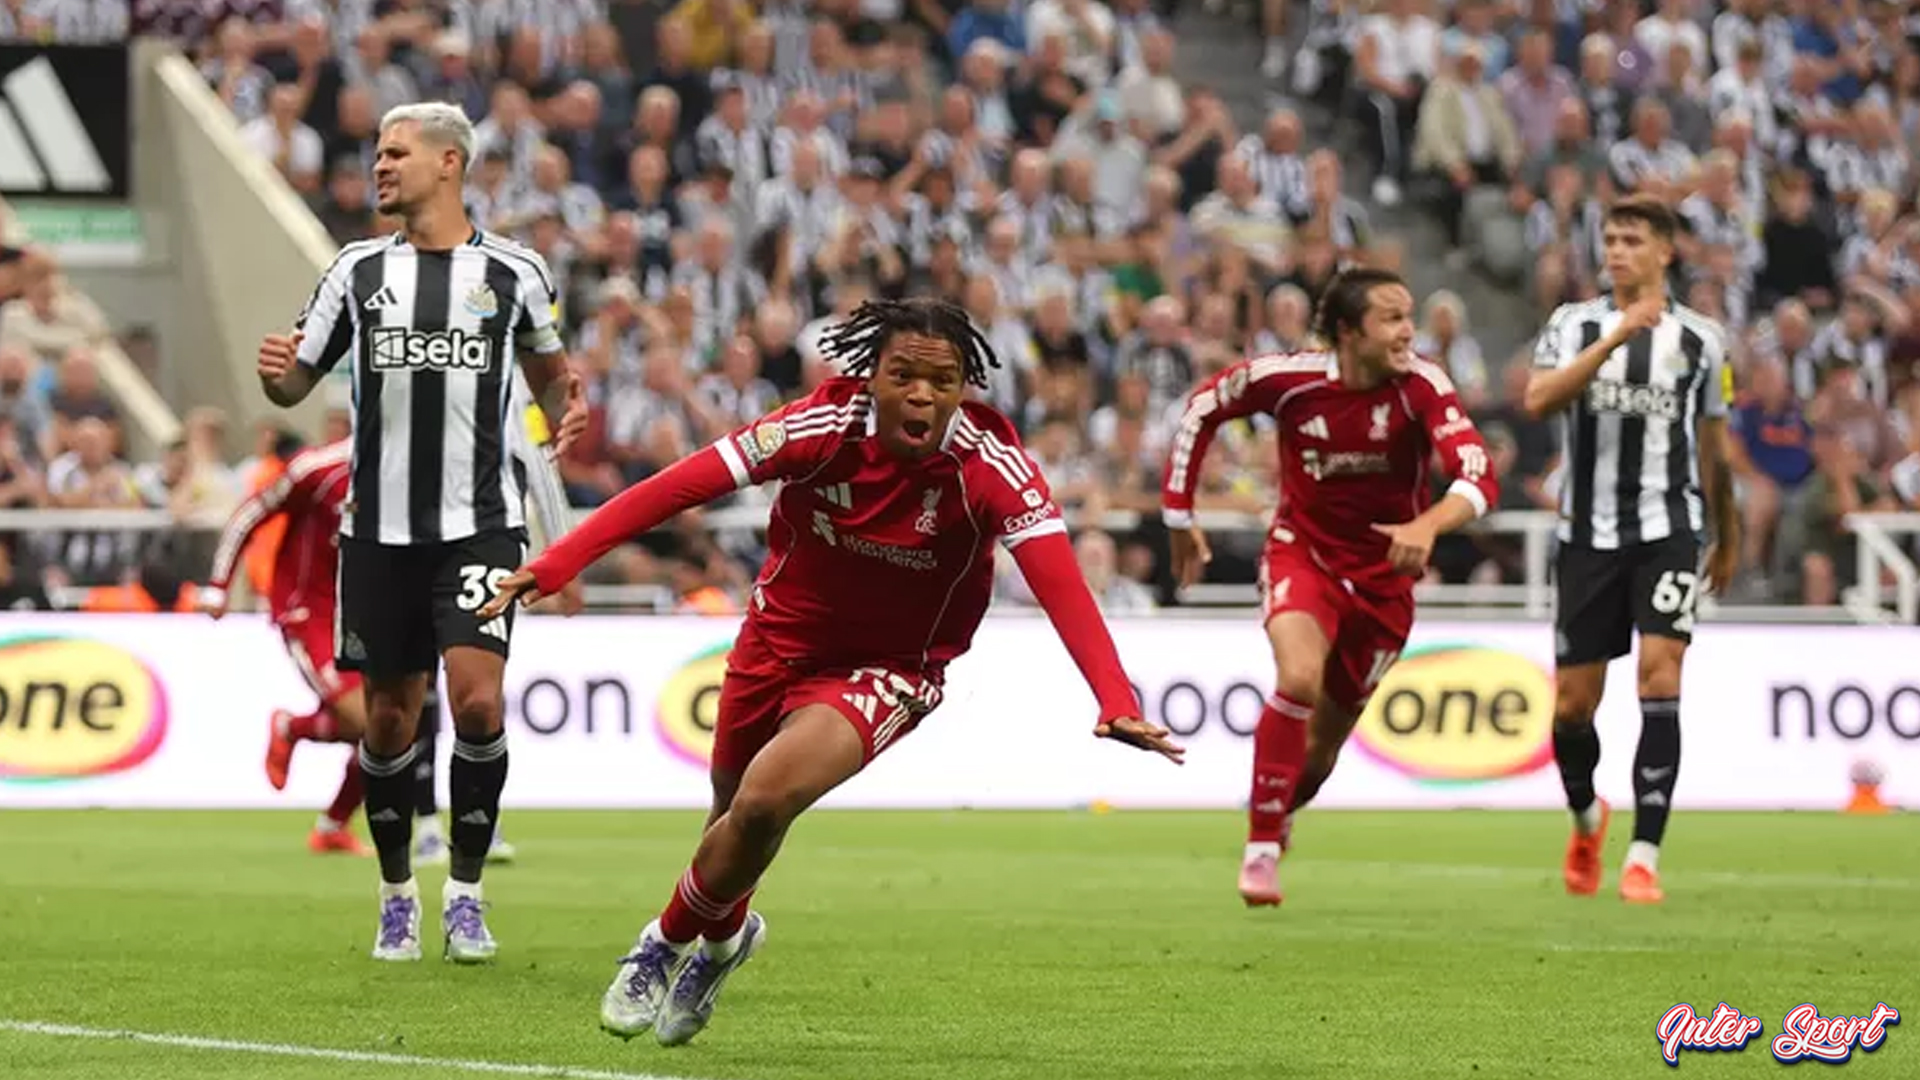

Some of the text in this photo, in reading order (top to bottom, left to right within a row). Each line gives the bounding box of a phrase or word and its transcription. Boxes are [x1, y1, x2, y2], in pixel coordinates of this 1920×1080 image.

[406, 331, 487, 367] sela
[1619, 384, 1678, 417] sela
[1652, 570, 1698, 614] 67
[0, 681, 125, 731] ne
[521, 678, 631, 735] on
[1383, 688, 1530, 737] one
[1772, 685, 1920, 740] noo
